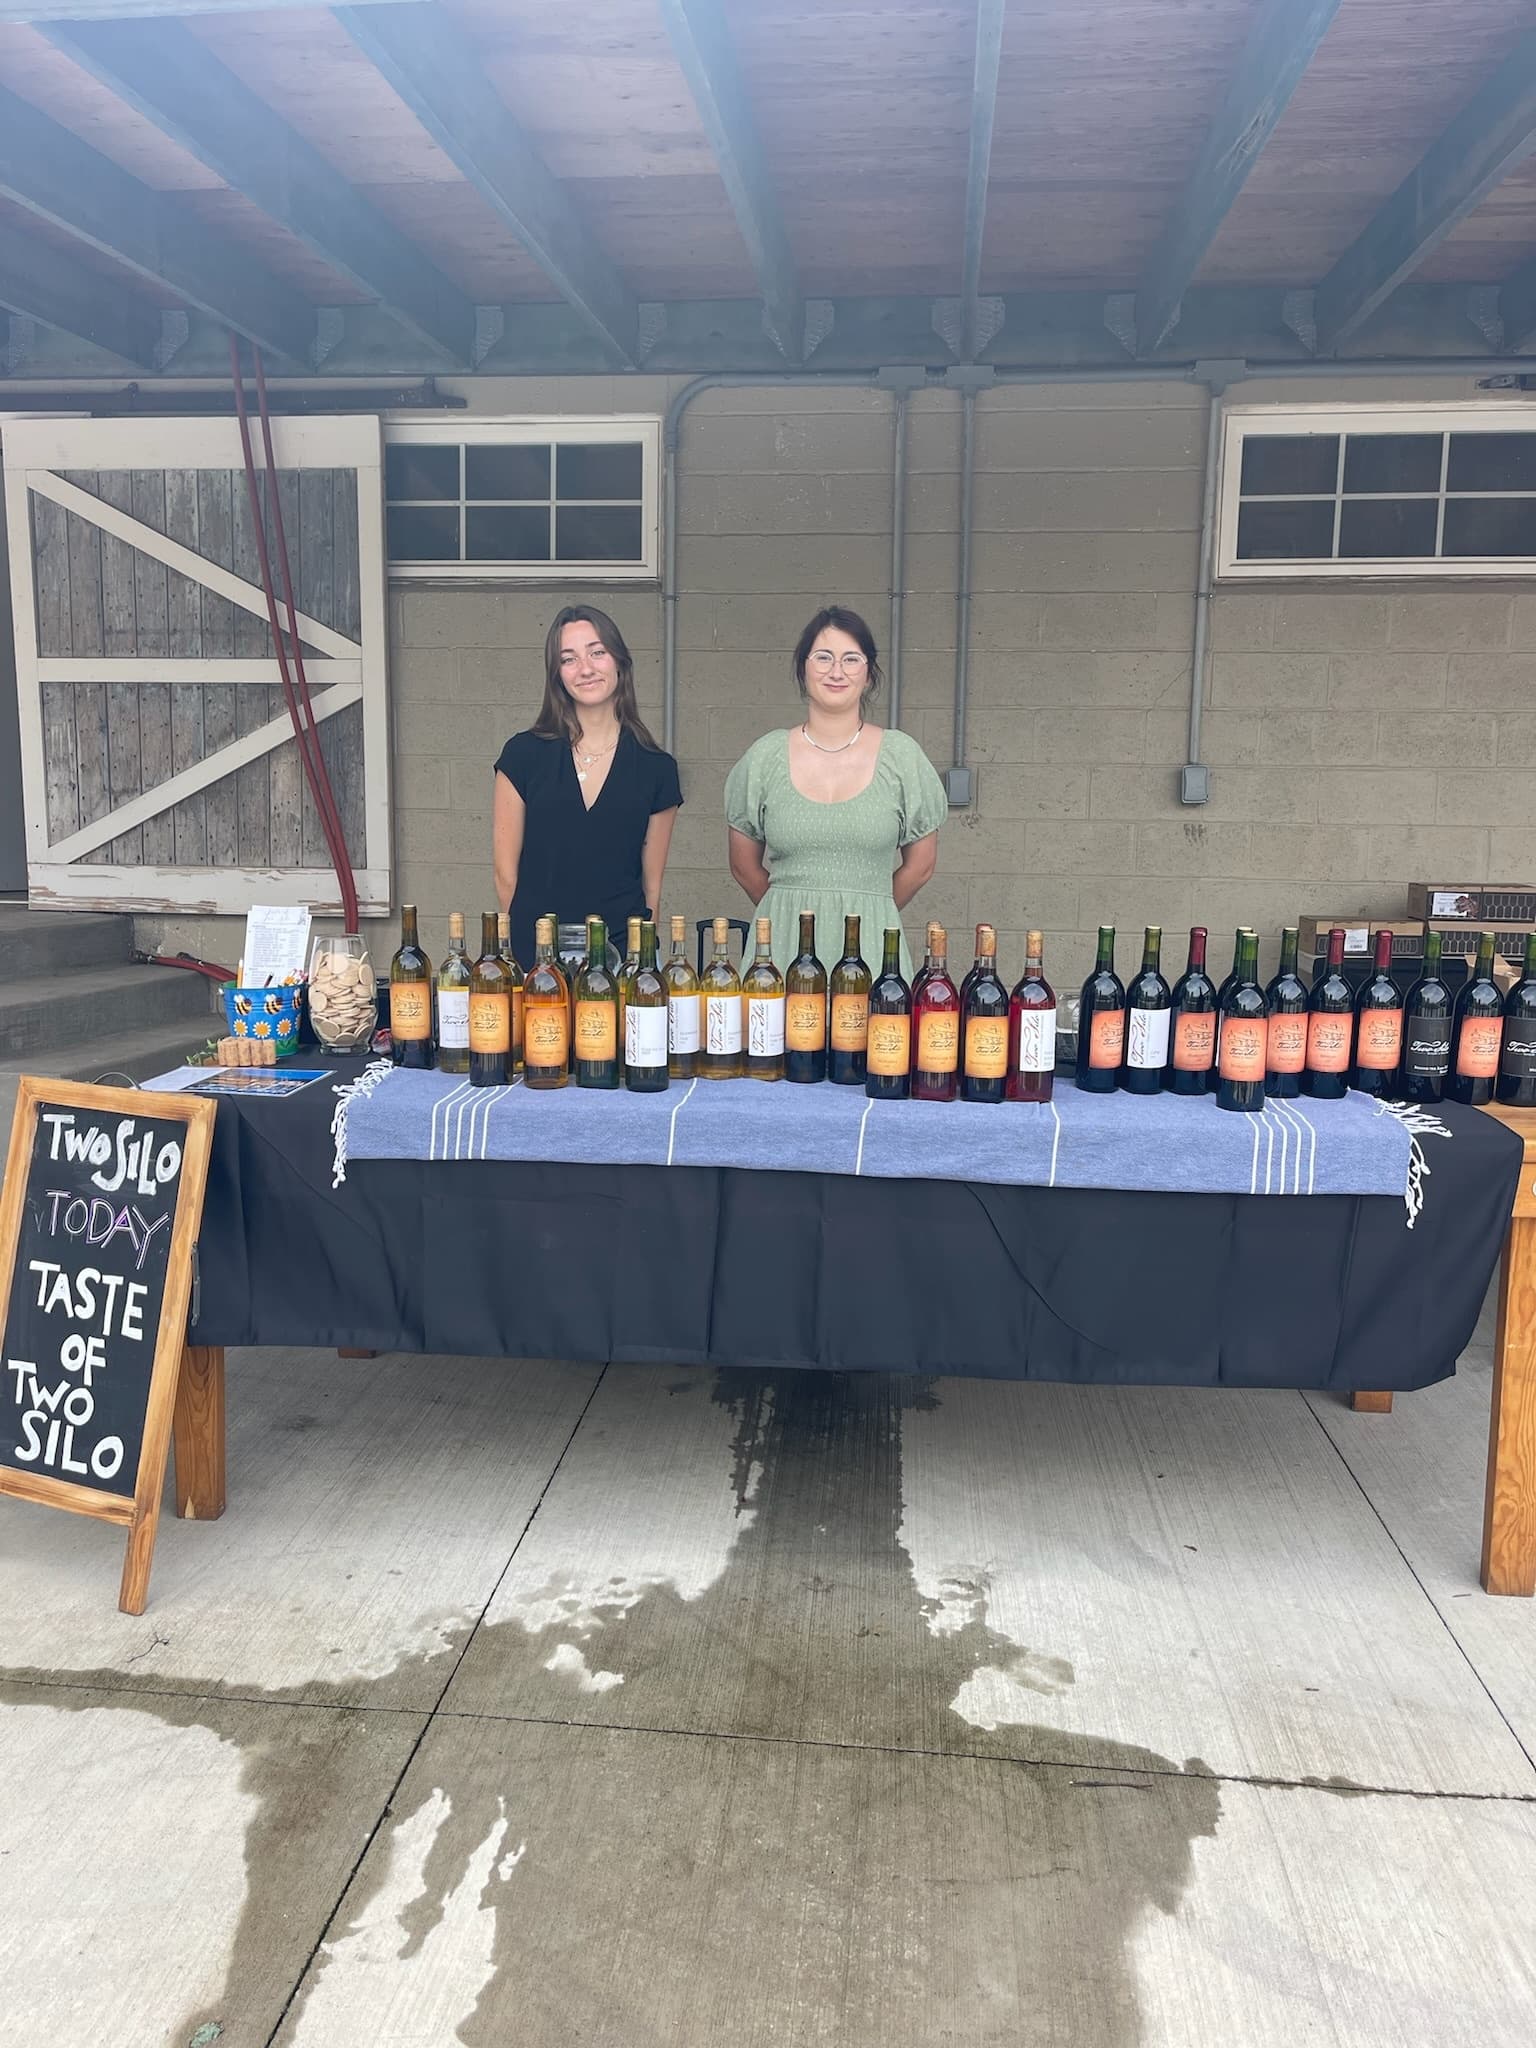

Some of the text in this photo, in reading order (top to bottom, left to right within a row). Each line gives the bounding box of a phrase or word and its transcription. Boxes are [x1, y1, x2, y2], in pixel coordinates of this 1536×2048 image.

[709, 999, 724, 1052] Two Silo
[751, 1000, 766, 1054] Two Silo
[1023, 1015, 1041, 1068] Two Silo
[1131, 1013, 1147, 1065] Two Silo
[45, 1189, 170, 1270] TODAY
[29, 1260, 148, 1341] TASTE
[60, 1333, 107, 1386] OF
[8, 1359, 95, 1426] TWO
[14, 1409, 124, 1479] SILO
